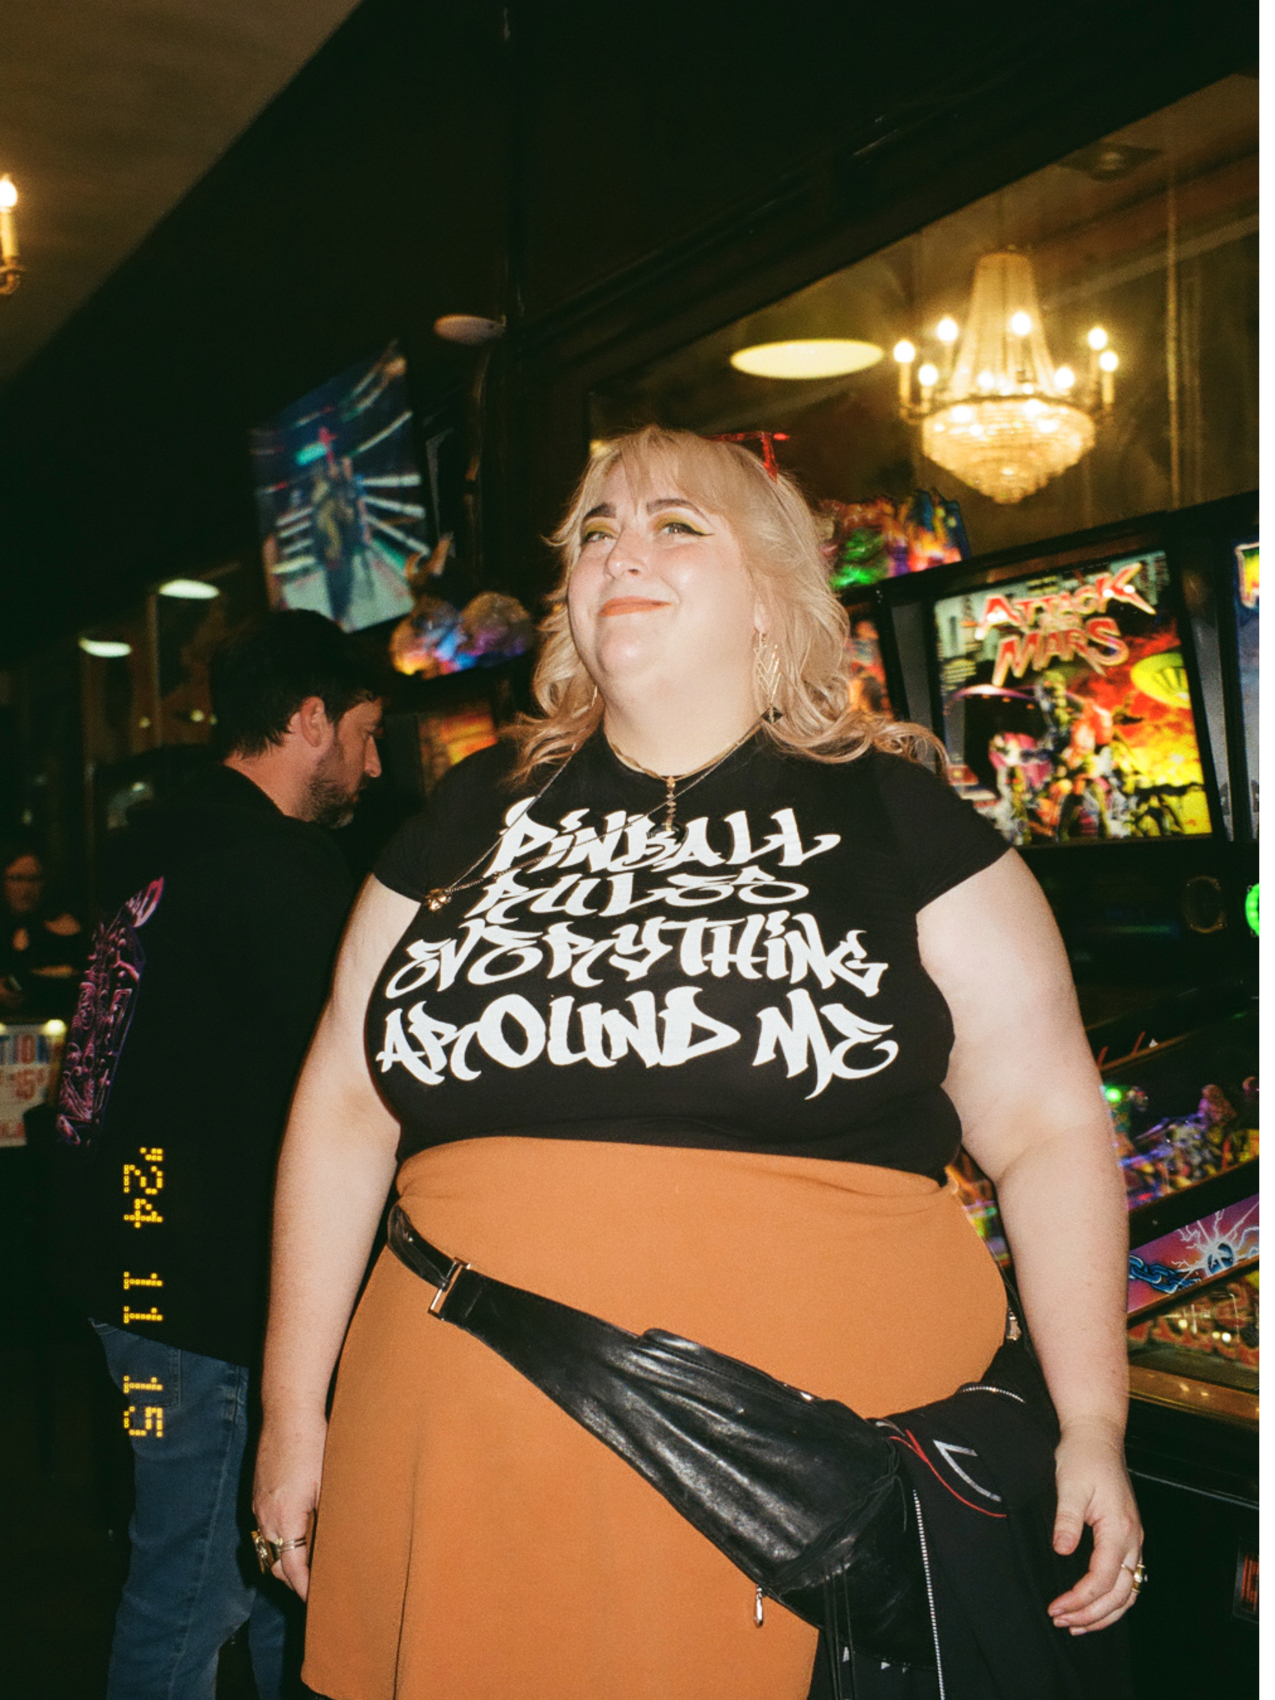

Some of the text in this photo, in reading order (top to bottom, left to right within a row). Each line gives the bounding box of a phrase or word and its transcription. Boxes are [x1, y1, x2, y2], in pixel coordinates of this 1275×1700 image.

[974, 562, 1157, 641] ATTACK
[992, 617, 1129, 687] MARS
[465, 865, 809, 925] RULES
[384, 910, 889, 999] EVERYTHING
[376, 986, 899, 1101] AROUND ME
